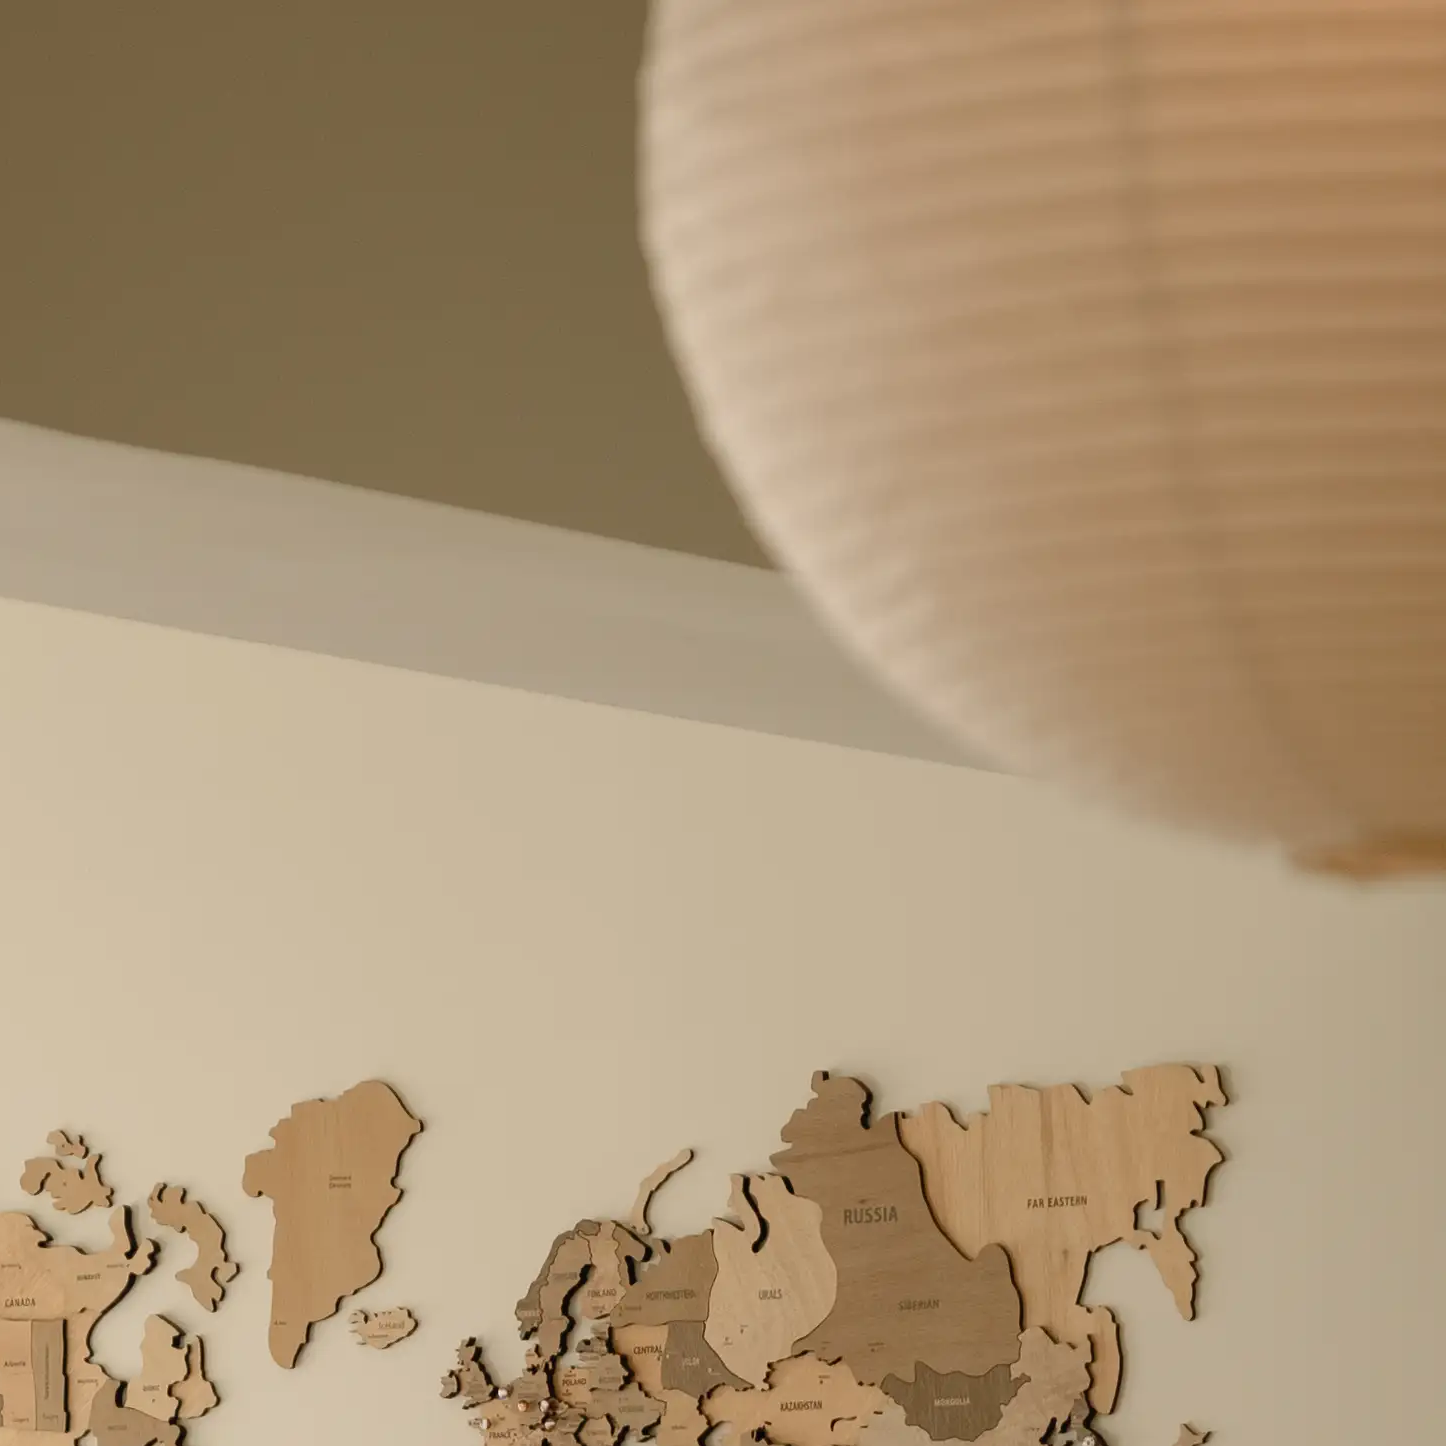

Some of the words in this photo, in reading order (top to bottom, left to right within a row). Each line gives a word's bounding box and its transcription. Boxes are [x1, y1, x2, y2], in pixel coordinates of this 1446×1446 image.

[1026, 1196, 1045, 1209] FAR
[1047, 1194, 1088, 1208] EASTERN
[843, 1206, 899, 1225] RUSSIA
[758, 1289, 783, 1300] URALS
[5, 1298, 36, 1308] CANADA
[897, 1298, 940, 1311] SIBERIAN
[633, 1345, 663, 1355] CENTRAL
[561, 1378, 587, 1387] POLAND
[779, 1400, 823, 1412] KAZAKHSTAN
